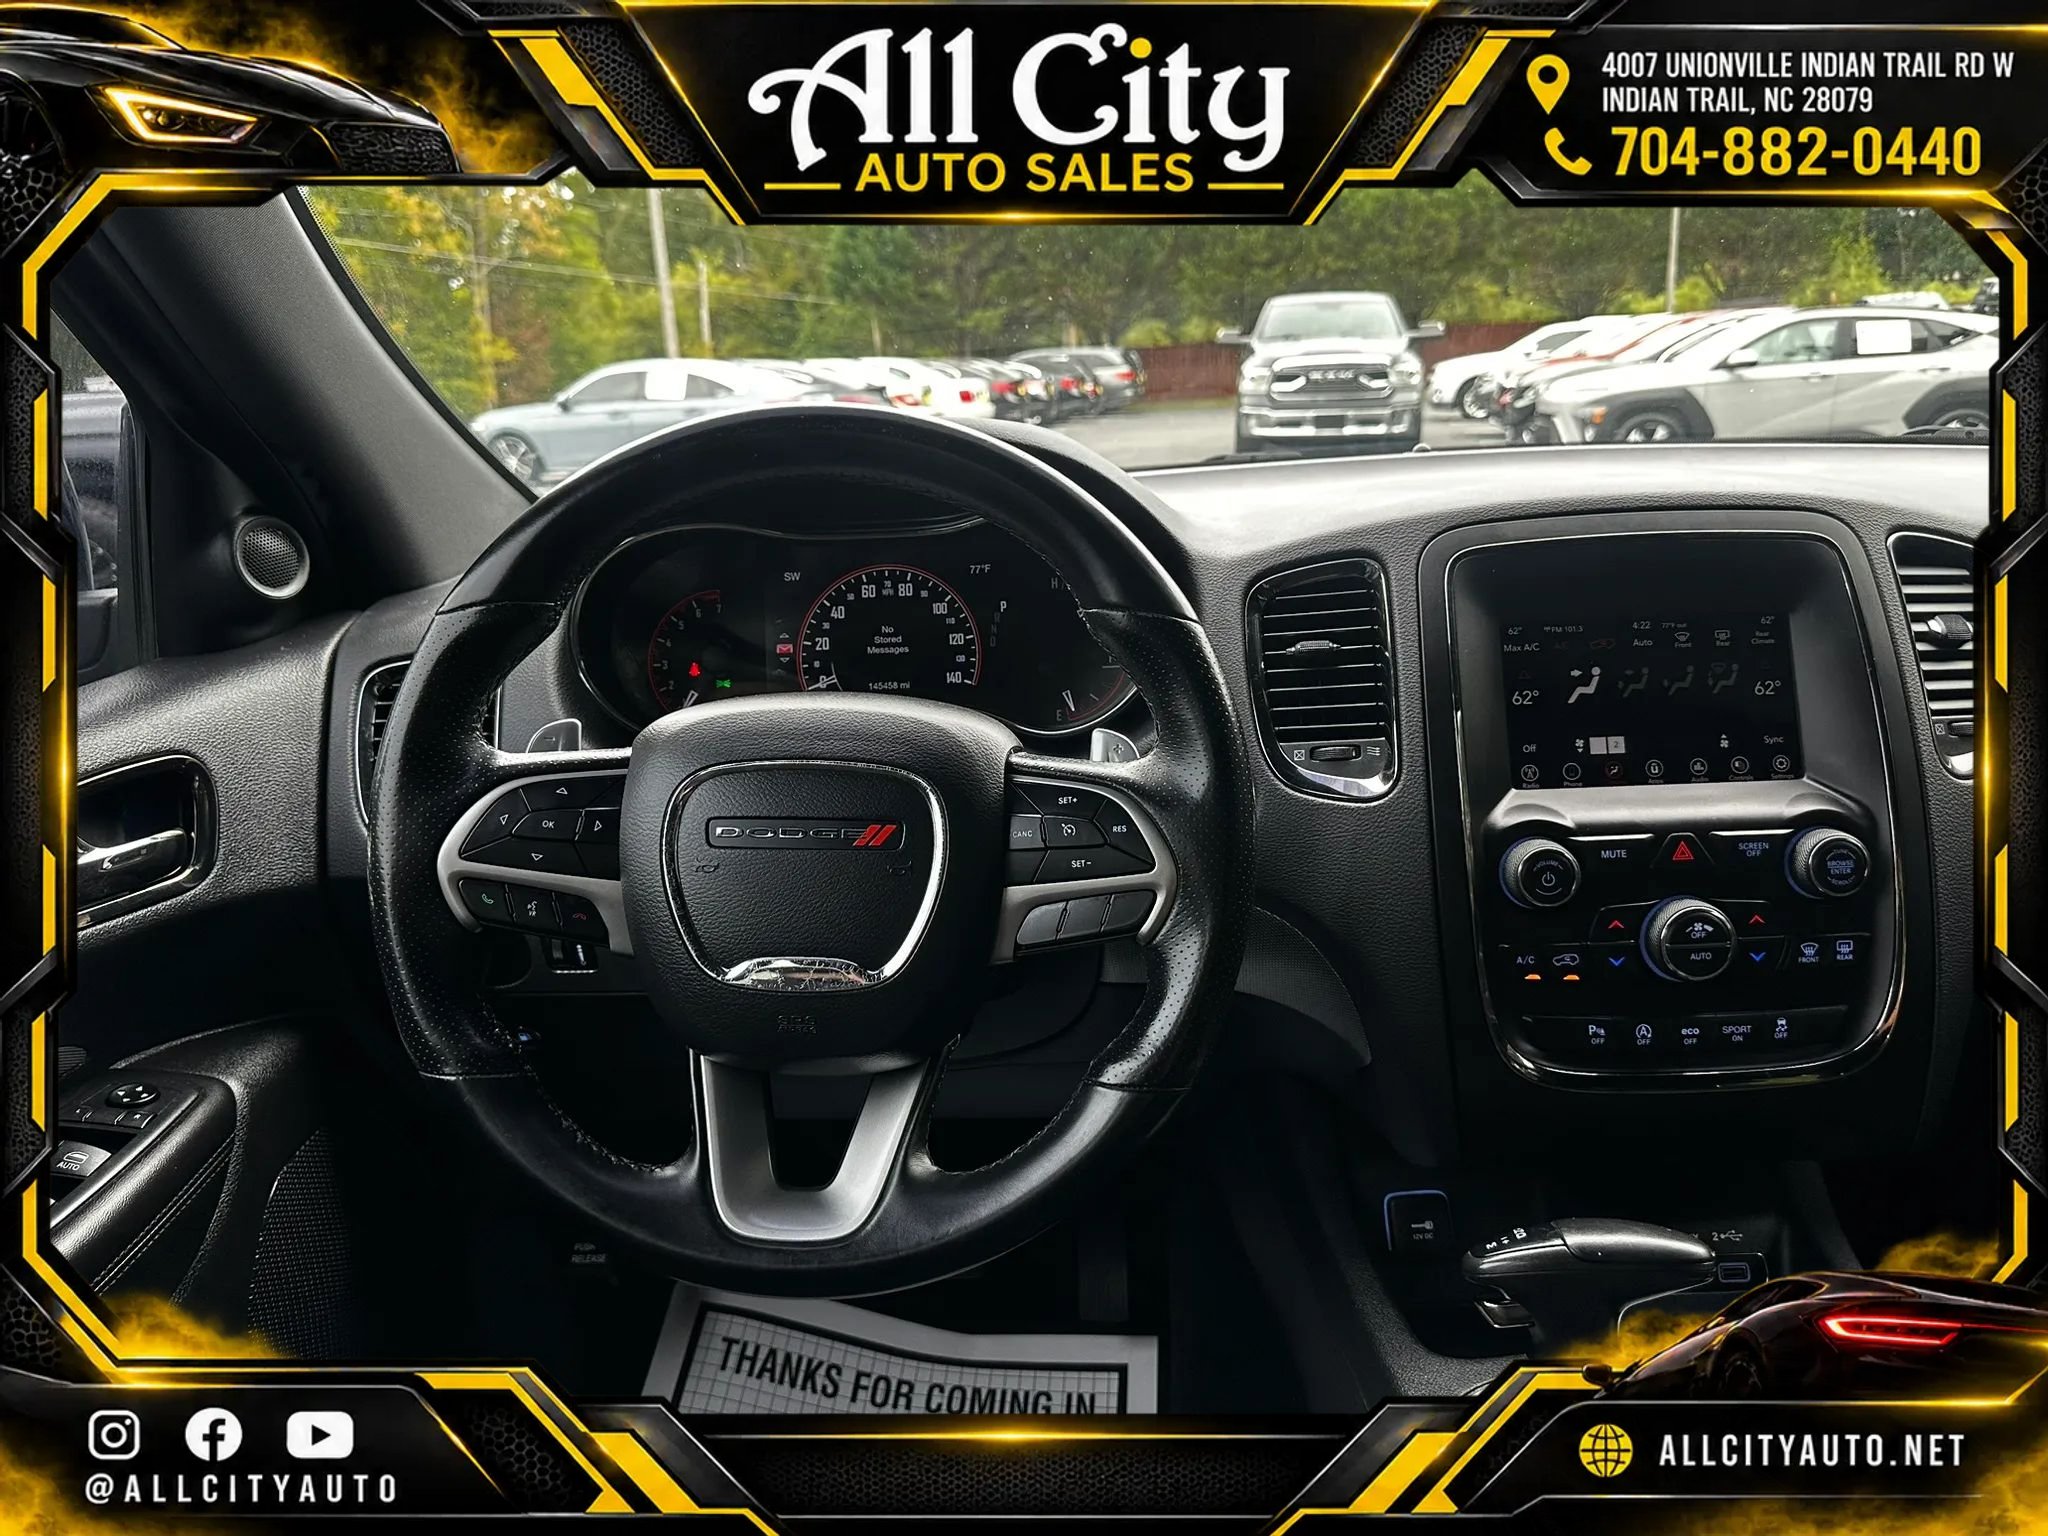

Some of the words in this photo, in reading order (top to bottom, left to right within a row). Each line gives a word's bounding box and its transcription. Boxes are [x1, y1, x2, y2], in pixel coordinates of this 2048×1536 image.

[784, 572, 801, 582] SW
[861, 584, 876, 598] 60
[898, 583, 913, 597] 80
[932, 602, 948, 615] 100
[1000, 600, 1008, 613] P
[830, 605, 846, 620] 40
[881, 625, 894, 633] No
[1632, 620, 1652, 630] 4:22
[815, 637, 830, 651] 20
[873, 635, 902, 644] Stored
[949, 633, 964, 645] 120
[1632, 638, 1654, 647] Auto
[866, 645, 910, 656] Messages
[1503, 643, 1522, 652] Max
[1523, 642, 1541, 652] A/C
[946, 672, 962, 684] 140
[868, 682, 900, 691] 145458
[901, 681, 911, 689] mi
[1754, 679, 1782, 696] 62°
[1511, 689, 1540, 705] 62°
[1763, 735, 1784, 745] Sync
[1522, 743, 1537, 753] Off
[541, 819, 556, 829] OK
[1112, 824, 1128, 833] RES
[715, 826, 868, 839] DODGE
[1012, 830, 1033, 839] CANC
[1738, 841, 1770, 850] SCREEN
[1601, 850, 1628, 859] MUTE
[1746, 849, 1762, 857] OFF
[1690, 930, 1706, 940] OFF
[1516, 956, 1536, 965] A/C
[1690, 952, 1712, 961] AUTO
[1836, 953, 1854, 961] REAR
[1681, 1027, 1700, 1035] eco
[1722, 1025, 1752, 1034] SPORT
[1732, 1034, 1744, 1042] ON
[1774, 1031, 1788, 1040] OFF
[1590, 1037, 1605, 1045] OFF
[1637, 1038, 1651, 1046] OFF
[1683, 1037, 1698, 1046] OFF
[56, 1161, 80, 1171] AUTO
[1711, 1231, 1720, 1241] 2
[720, 1336, 842, 1399] THANKS
[851, 1370, 916, 1411] FOR
[925, 1383, 1052, 1414] COMING
[1066, 1391, 1094, 1414] IN
